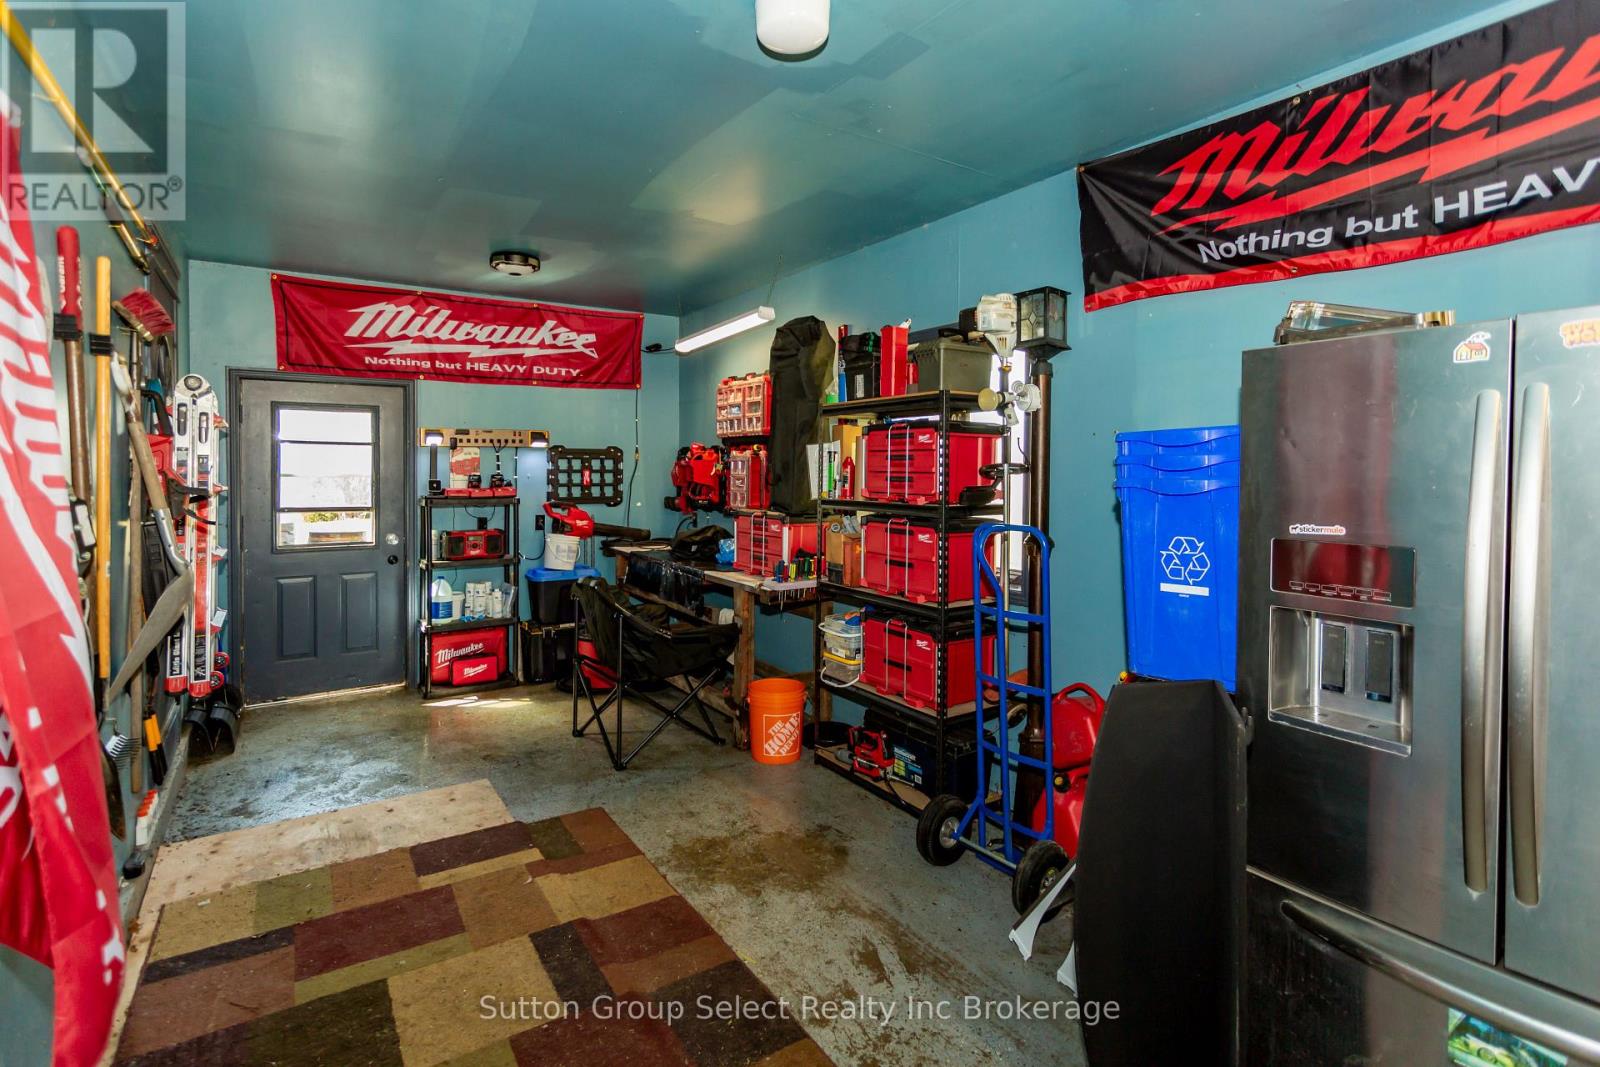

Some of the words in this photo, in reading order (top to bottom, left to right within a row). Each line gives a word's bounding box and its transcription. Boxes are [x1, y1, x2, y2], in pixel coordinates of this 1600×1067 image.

[1197, 224, 1333, 264] Nothing
[1345, 203, 1418, 239] but
[344, 302, 597, 358] Milwaukee
[364, 355, 431, 369] Nothing
[435, 359, 462, 371] but
[466, 361, 527, 375] HEAVY
[1299, 525, 1344, 534] stickermule
[435, 642, 484, 664] Milwaukee
[765, 713, 800, 756] HOME
[768, 720, 784, 736] THE
